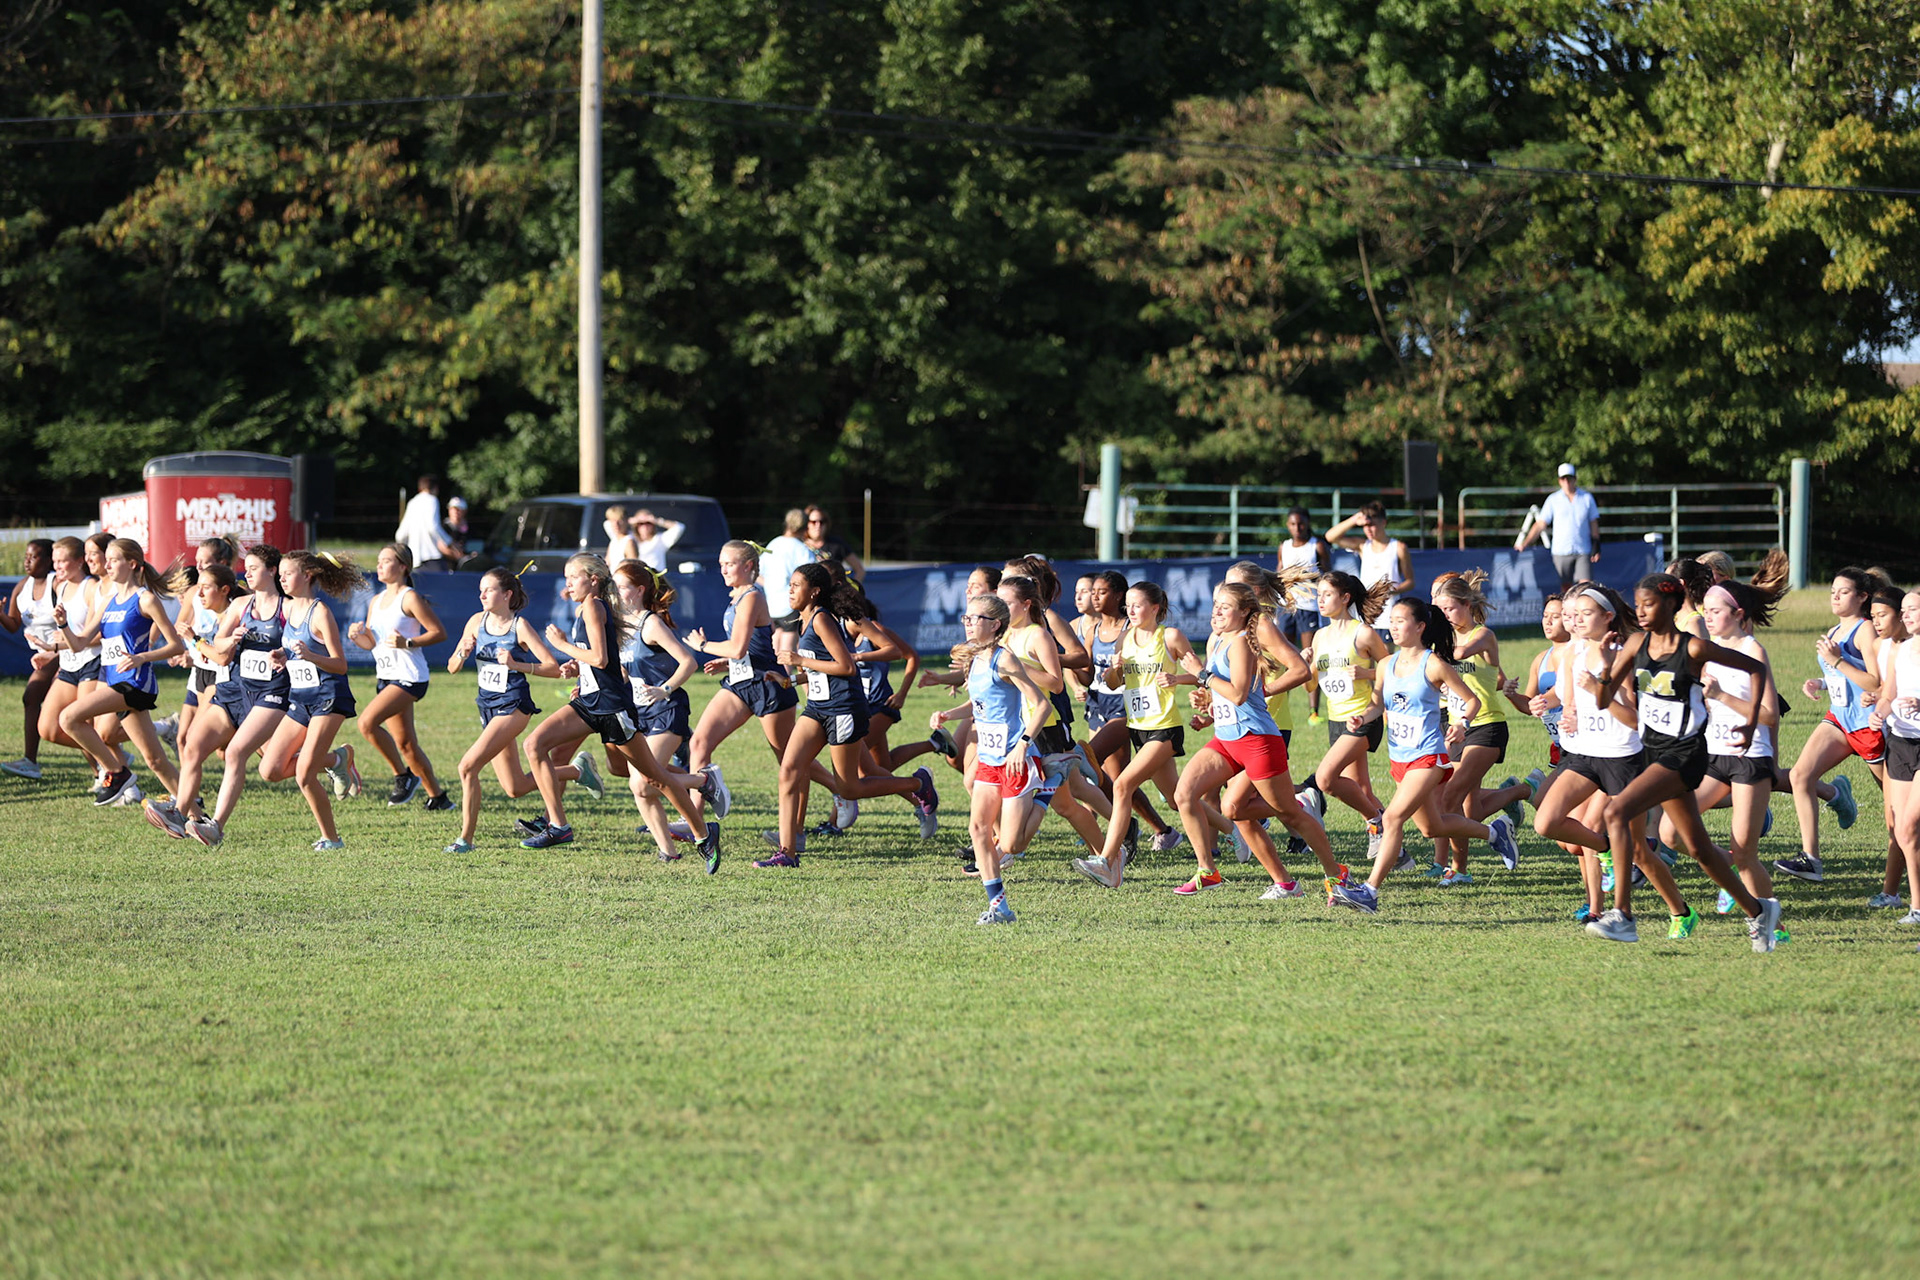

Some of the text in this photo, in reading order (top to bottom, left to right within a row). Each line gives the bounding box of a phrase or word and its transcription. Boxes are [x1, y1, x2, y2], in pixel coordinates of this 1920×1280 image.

[176, 497, 277, 522] MEMPHIS
[185, 519, 265, 537] RUNNERS
[1123, 661, 1164, 675] HUTCHISON
[1324, 679, 1347, 693] 669
[1635, 668, 1677, 697] M
[1131, 695, 1151, 712] 675
[1645, 704, 1672, 727] 964
